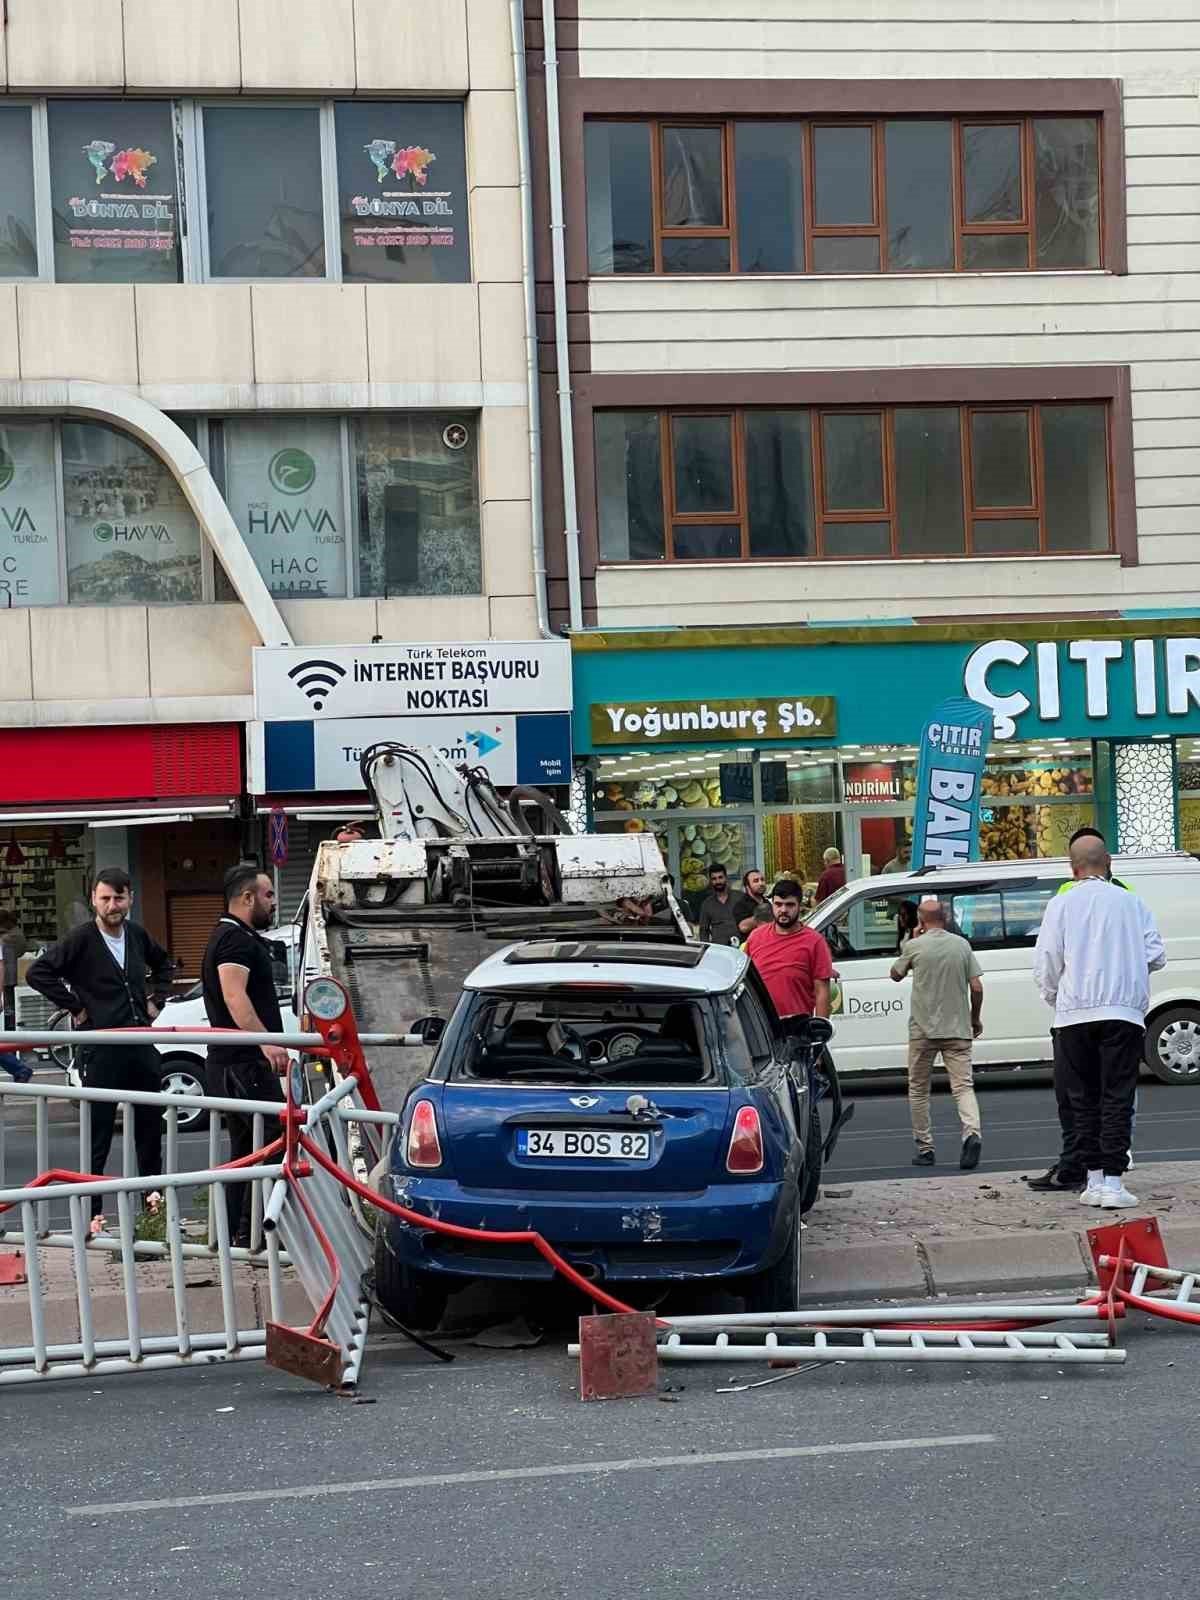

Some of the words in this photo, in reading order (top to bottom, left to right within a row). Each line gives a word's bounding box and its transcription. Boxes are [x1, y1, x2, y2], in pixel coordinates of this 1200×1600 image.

[142, 202, 174, 219] DİL
[422, 198, 454, 215] DİL
[248, 509, 337, 534] HAVVA
[115, 525, 170, 541] HAVVA
[271, 557, 318, 575] HAC
[407, 649, 433, 660] Türk
[436, 648, 487, 658] Telekom
[353, 659, 447, 682] İNTERNET
[451, 660, 540, 684] BAŞVURU
[964, 638, 1200, 740] ÇITIR
[406, 689, 489, 709] NOKTASI
[606, 704, 768, 736] Yoğunburç
[778, 702, 822, 734] Şb.
[927, 723, 983, 747] ÇITIR
[940, 744, 982, 757] tanzim
[540, 759, 562, 768] Mobil
[848, 998, 903, 1016] Derya
[529, 1133, 554, 1154] 34
[564, 1133, 611, 1155] BOS
[621, 1135, 646, 1156] 82
